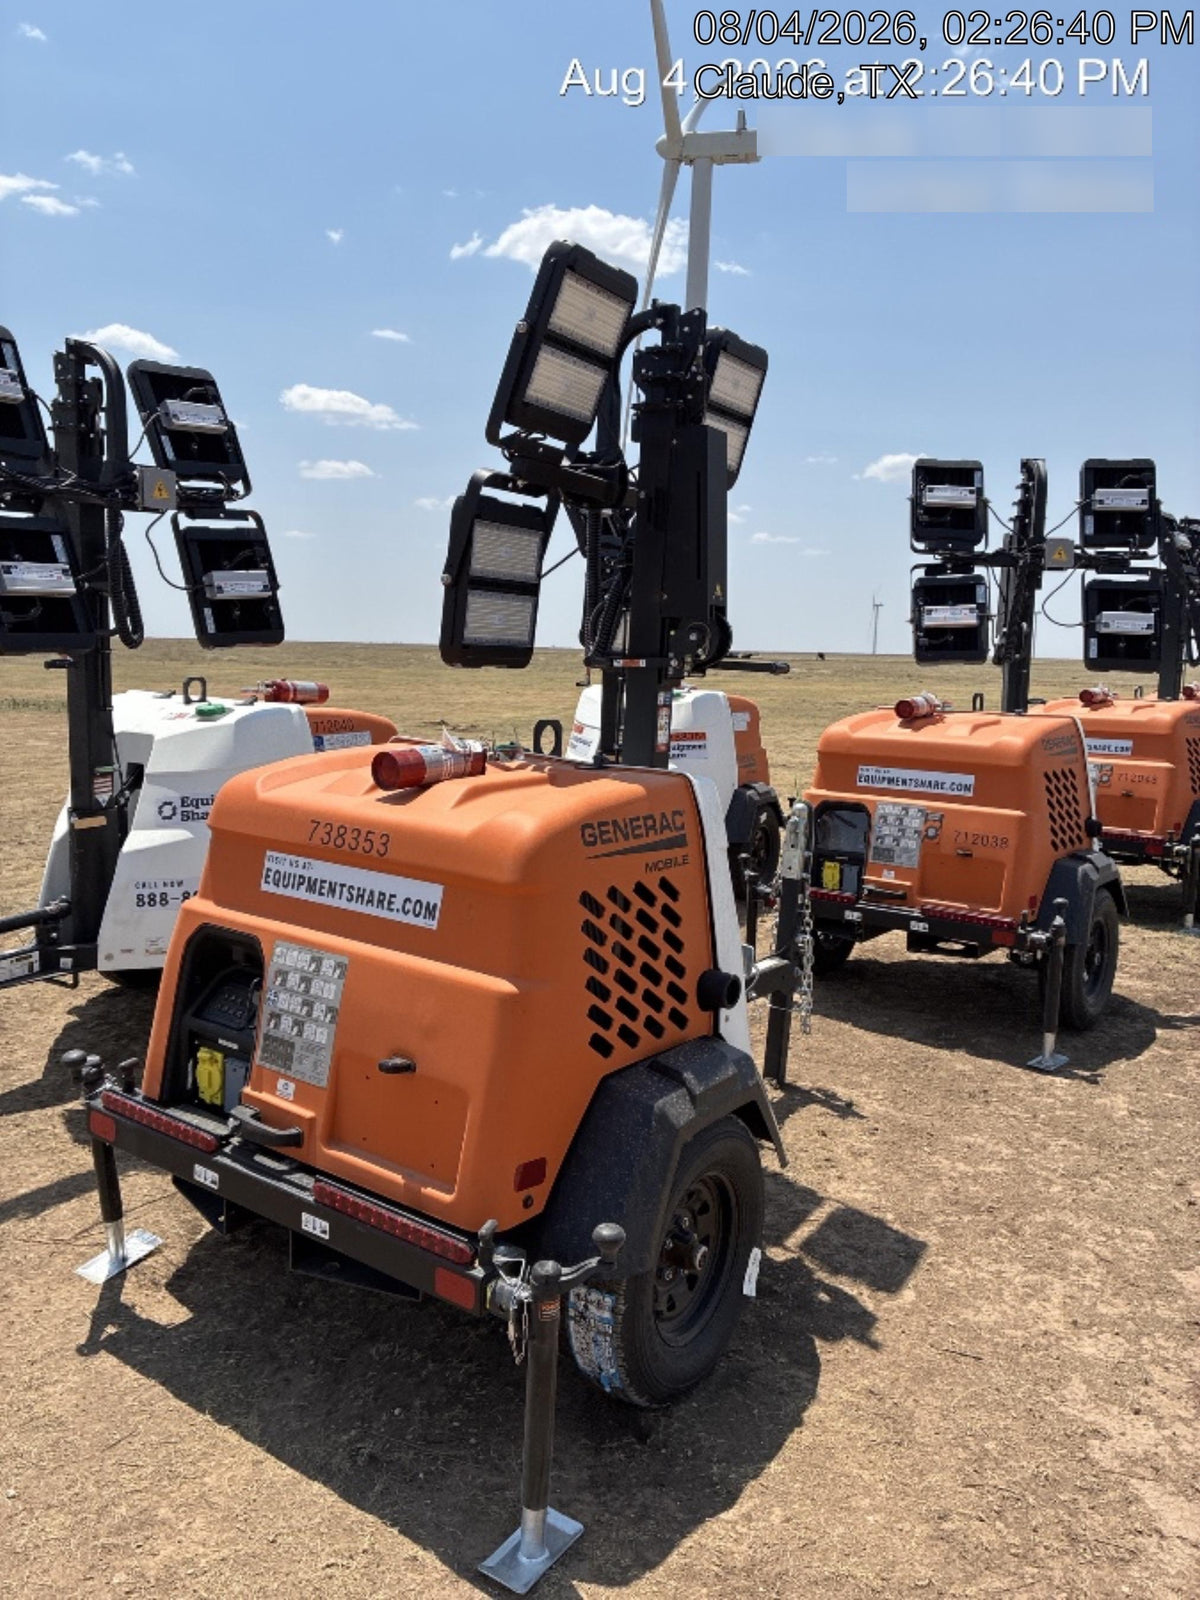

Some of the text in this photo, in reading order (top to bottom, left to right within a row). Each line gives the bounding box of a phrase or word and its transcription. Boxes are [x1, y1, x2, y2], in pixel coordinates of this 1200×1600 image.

[180, 794, 216, 810] Equi
[180, 809, 210, 822] Sha
[580, 810, 686, 847] GENERAC
[308, 819, 390, 858] 738353
[953, 830, 1009, 848] 712038
[644, 855, 690, 874] MOBILE
[136, 890, 198, 908] 888-8
[264, 867, 438, 922] EQUIPMENTSHARE.COM
